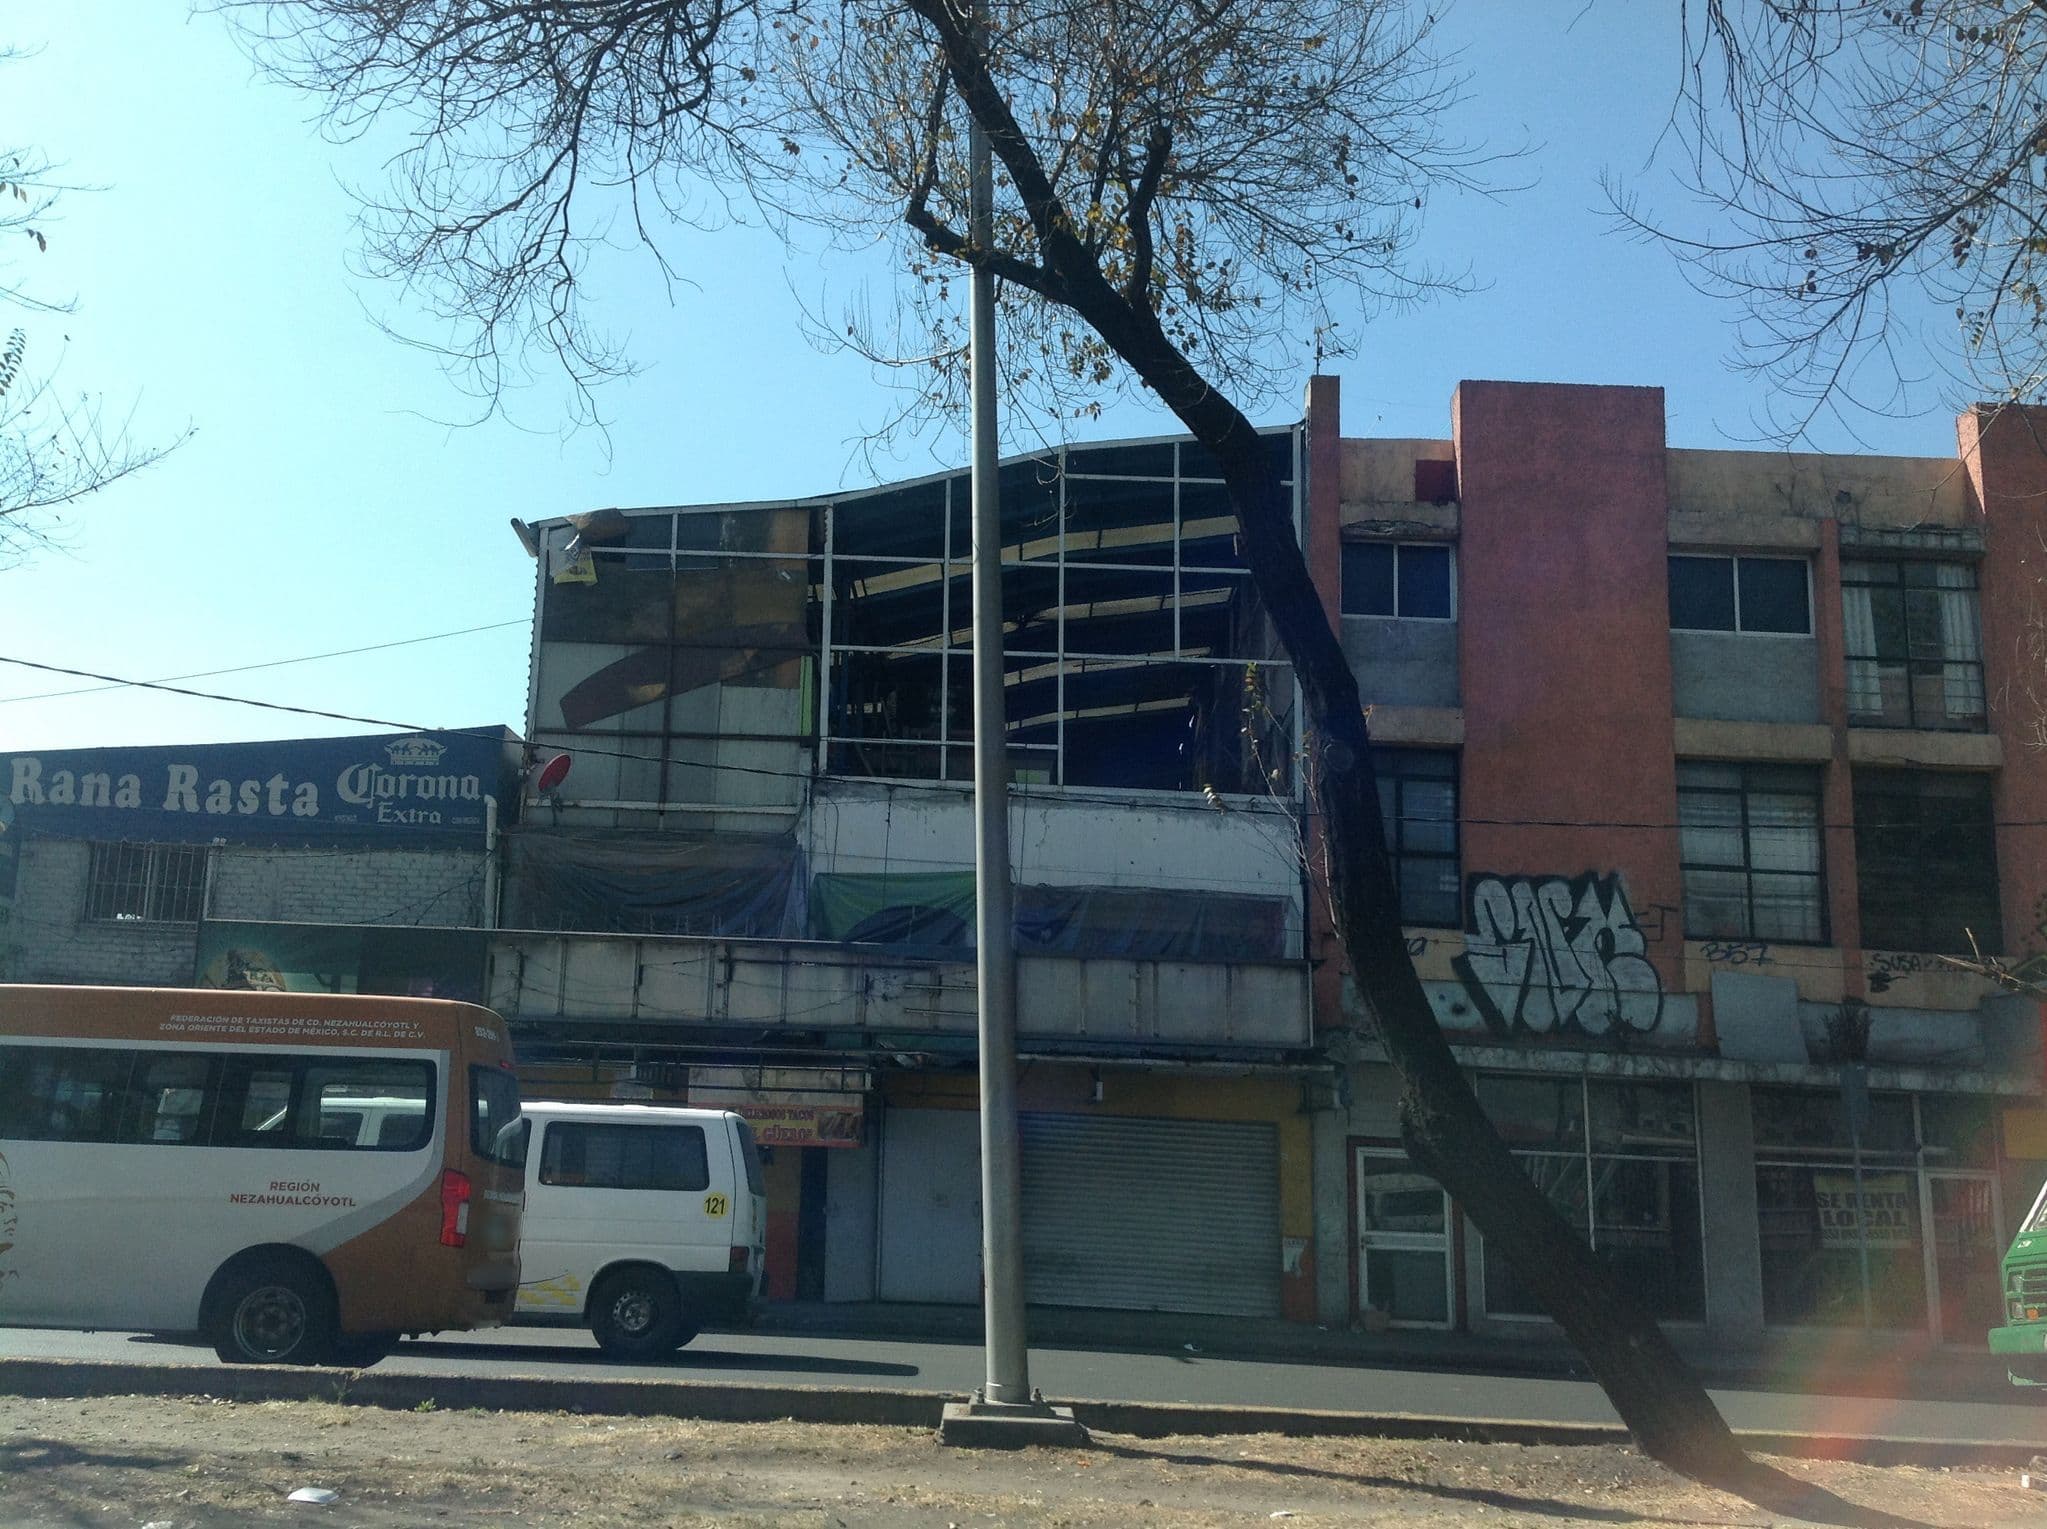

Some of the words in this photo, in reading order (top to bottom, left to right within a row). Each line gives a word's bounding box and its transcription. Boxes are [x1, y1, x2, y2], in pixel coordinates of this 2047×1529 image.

[10, 756, 142, 809] Rana
[163, 763, 320, 817] Rasta
[336, 762, 481, 809] Corona
[377, 801, 442, 824] Extra
[170, 1014, 229, 1024] FEDERACIÓN
[230, 1016, 244, 1024] DE
[245, 1016, 289, 1026] TAXISTAS
[291, 1018, 305, 1026] DE
[323, 1018, 411, 1029] NEZAHUALCÓYOTL
[159, 1023, 186, 1031] ZONA
[187, 1024, 227, 1032] ORIENTE
[248, 1026, 286, 1034] ESTADO
[302, 1026, 341, 1036] MÉXICO,
[360, 1029, 374, 1037] DE
[787, 1108, 816, 1121] TACOS
[269, 1179, 321, 1192] REGIÓN
[230, 1194, 357, 1207] NEZAHUALCÓYOTL
[704, 1197, 725, 1215] 121
[1816, 1192, 1841, 1208] SE
[1823, 1210, 1907, 1227] LOCAL
